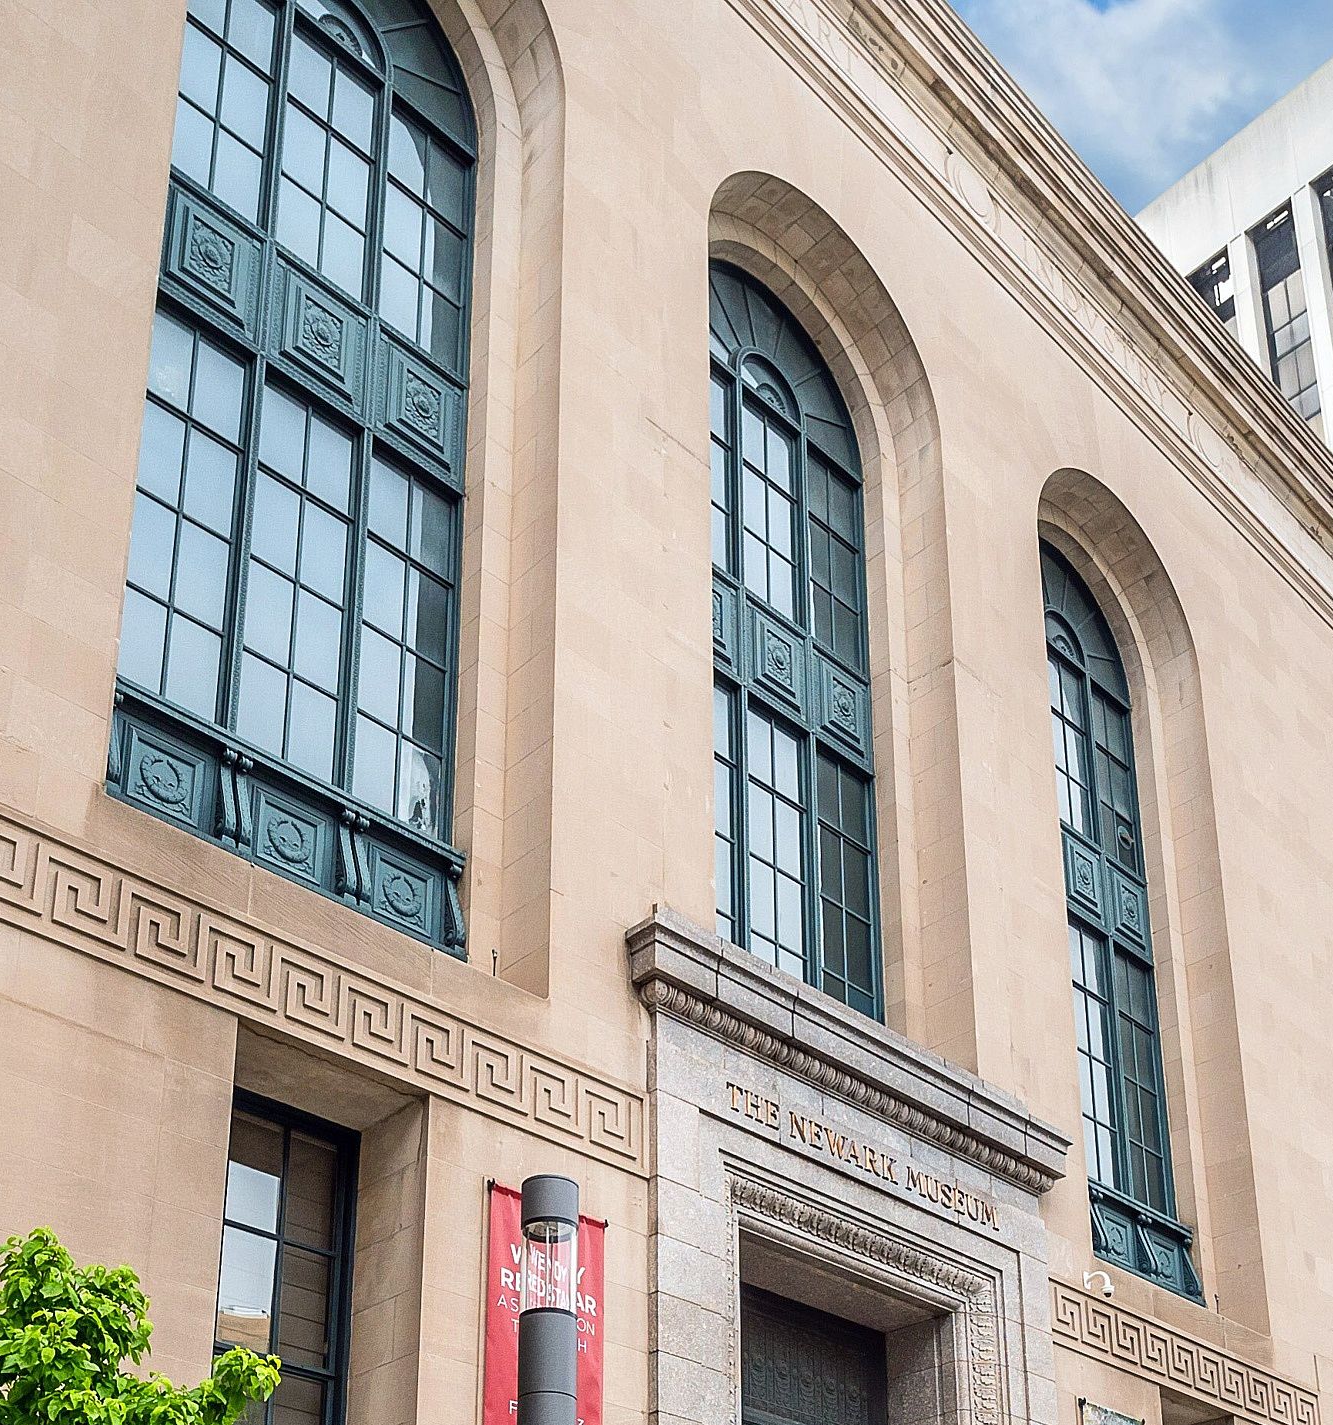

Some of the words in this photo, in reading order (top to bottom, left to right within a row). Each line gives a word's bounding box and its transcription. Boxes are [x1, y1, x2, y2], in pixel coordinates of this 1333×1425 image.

[726, 1082, 780, 1131] THE
[789, 1110, 899, 1186] NEWARK
[905, 1165, 1000, 1231] MUSEUM
